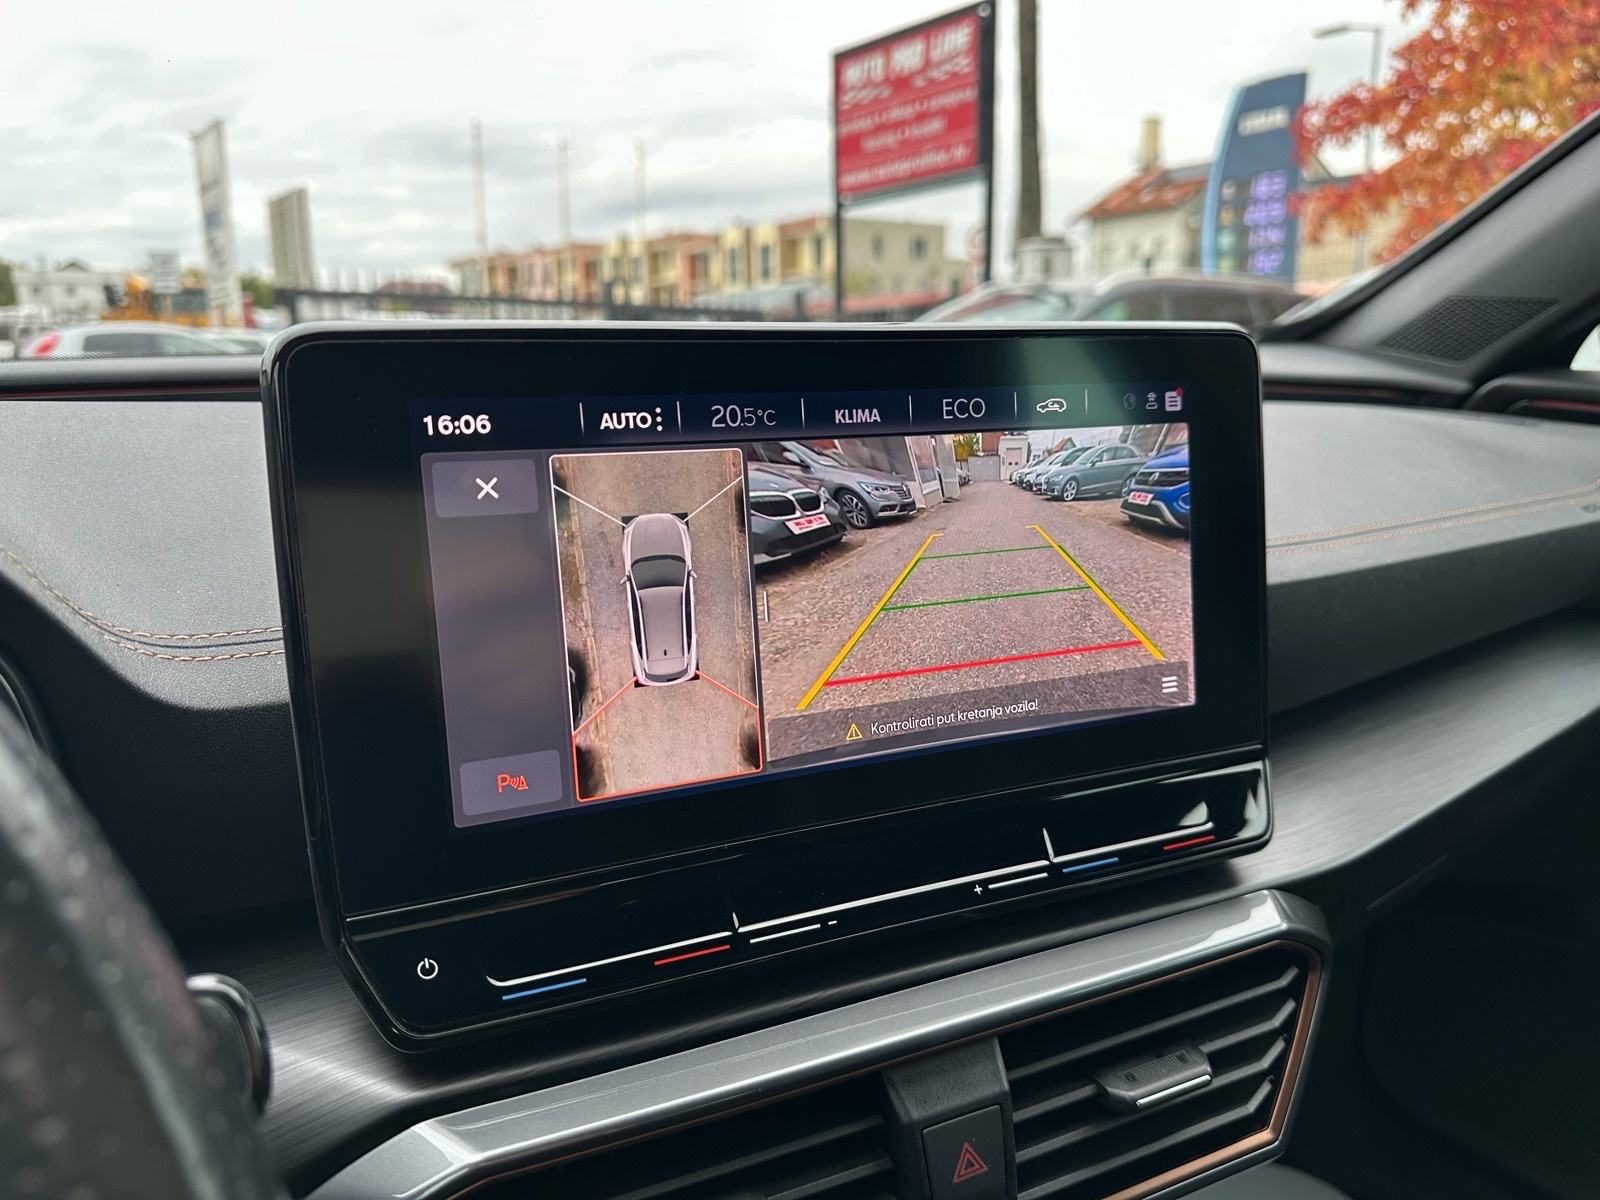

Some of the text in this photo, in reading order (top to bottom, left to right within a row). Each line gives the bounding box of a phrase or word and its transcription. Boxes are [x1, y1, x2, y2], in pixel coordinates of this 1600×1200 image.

[711, 404, 776, 428] 20.5°C
[834, 408, 881, 425] KLIMA
[942, 397, 986, 420] ECO
[423, 414, 492, 436] 16:06
[600, 411, 652, 430] AUTO
[871, 698, 1039, 735] Kontrolirati put kretanja vozila!
